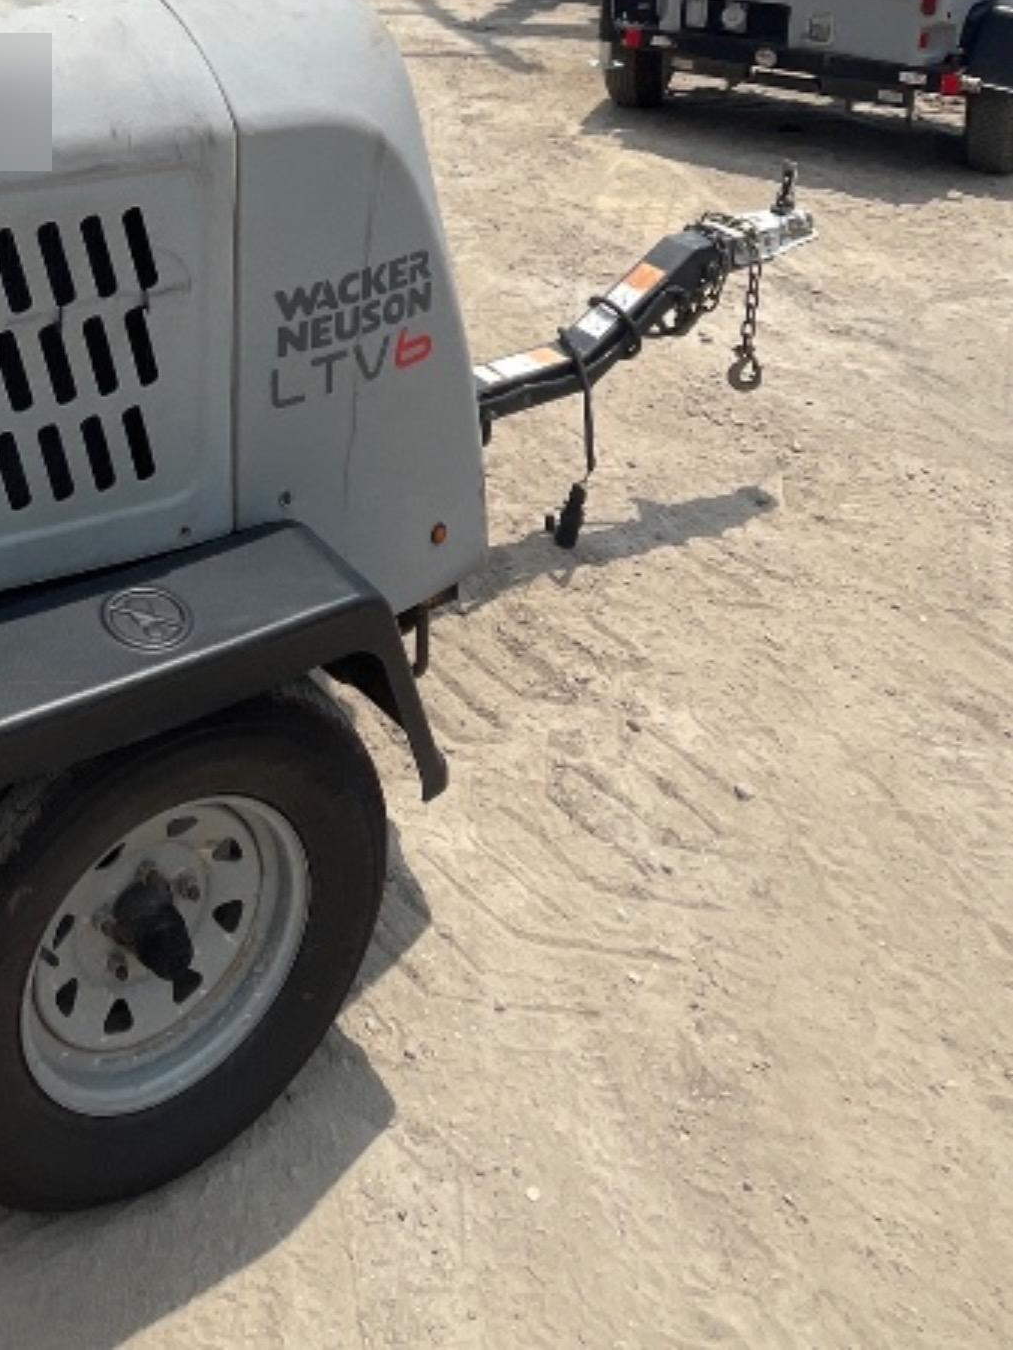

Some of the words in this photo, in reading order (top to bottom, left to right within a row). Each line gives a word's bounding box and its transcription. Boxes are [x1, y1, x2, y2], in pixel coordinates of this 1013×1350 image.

[274, 250, 432, 322] WACKER
[277, 282, 432, 358] NEUSON
[271, 326, 433, 409] LTV6
